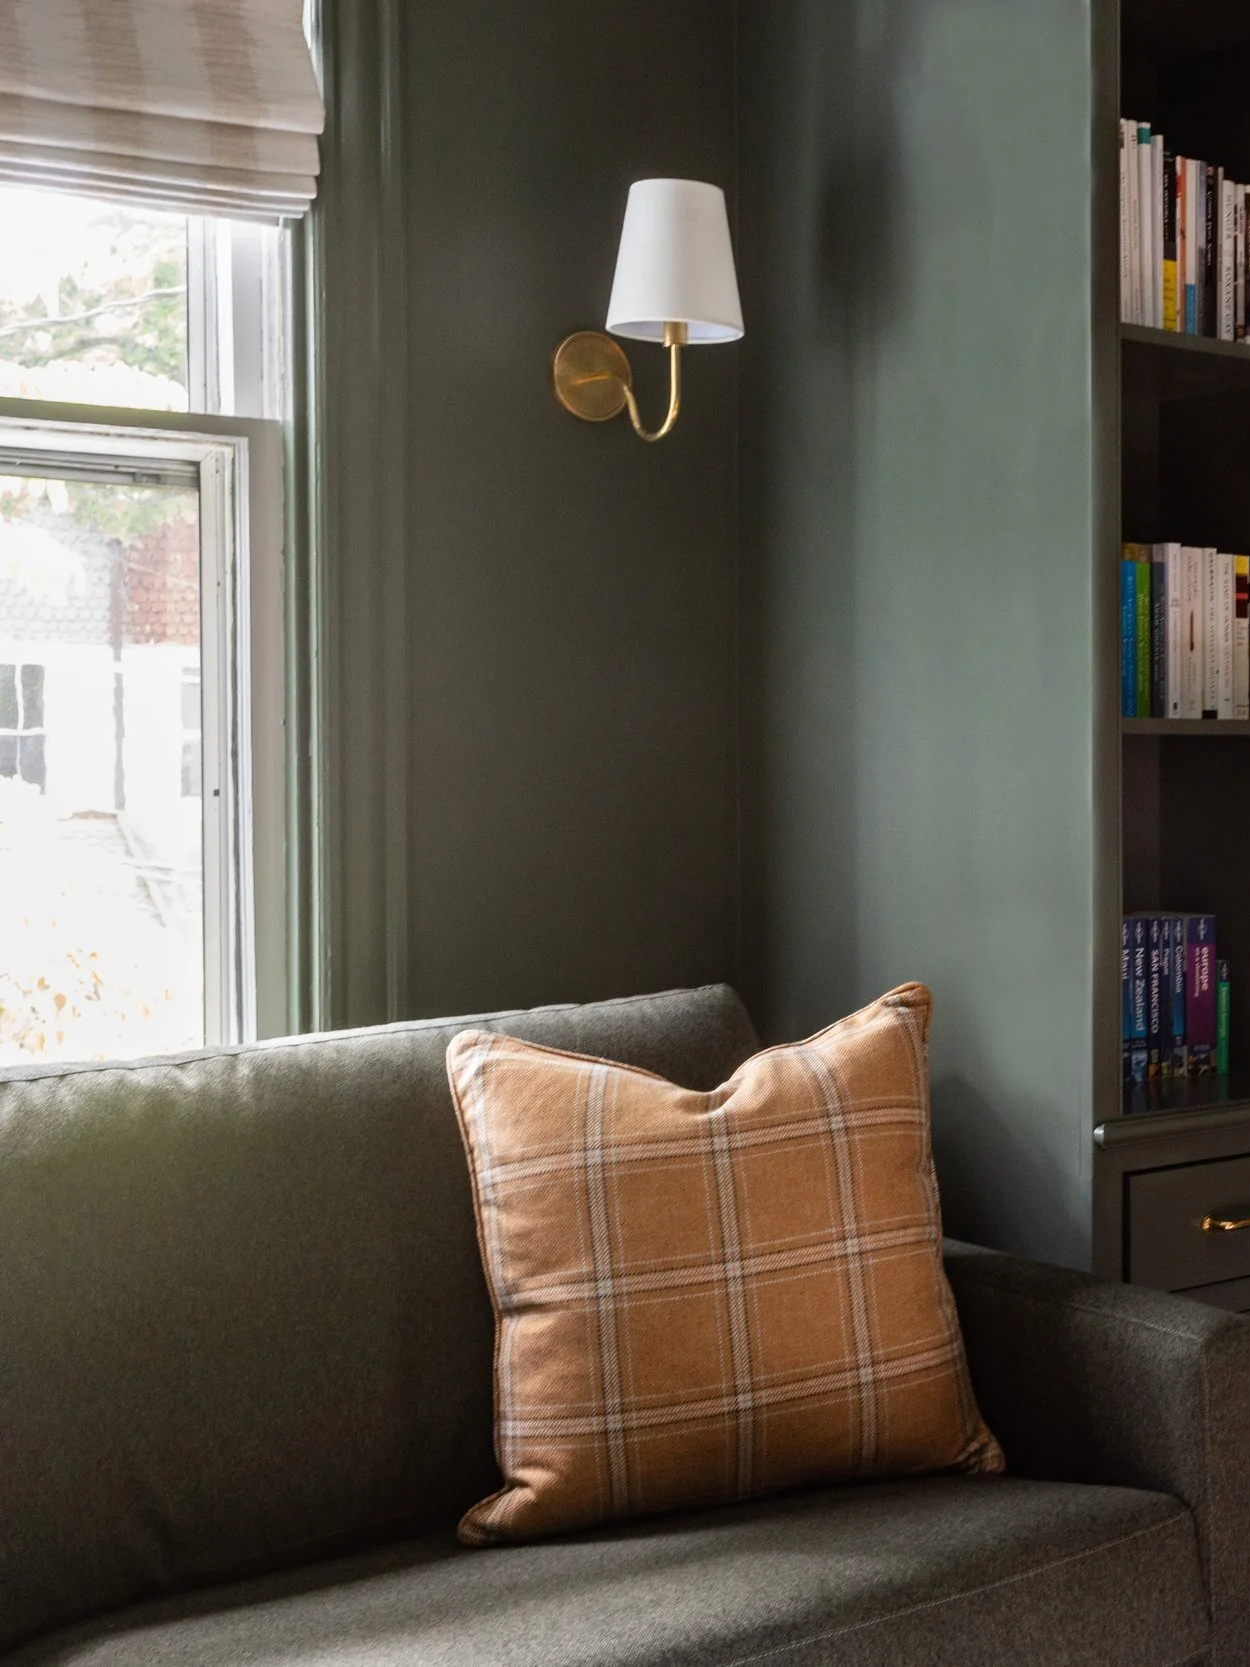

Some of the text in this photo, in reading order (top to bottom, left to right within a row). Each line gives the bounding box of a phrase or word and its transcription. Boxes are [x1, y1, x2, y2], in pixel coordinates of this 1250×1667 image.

[1223, 265, 1233, 309] ROXANE
[1121, 948, 1130, 980] Maui
[1161, 947, 1171, 976] Prague
[1174, 946, 1184, 993] Colombia
[1199, 945, 1211, 992] europe
[1133, 947, 1146, 1031] New Zealand
[1150, 948, 1159, 1034] SAN FRANCISCO
